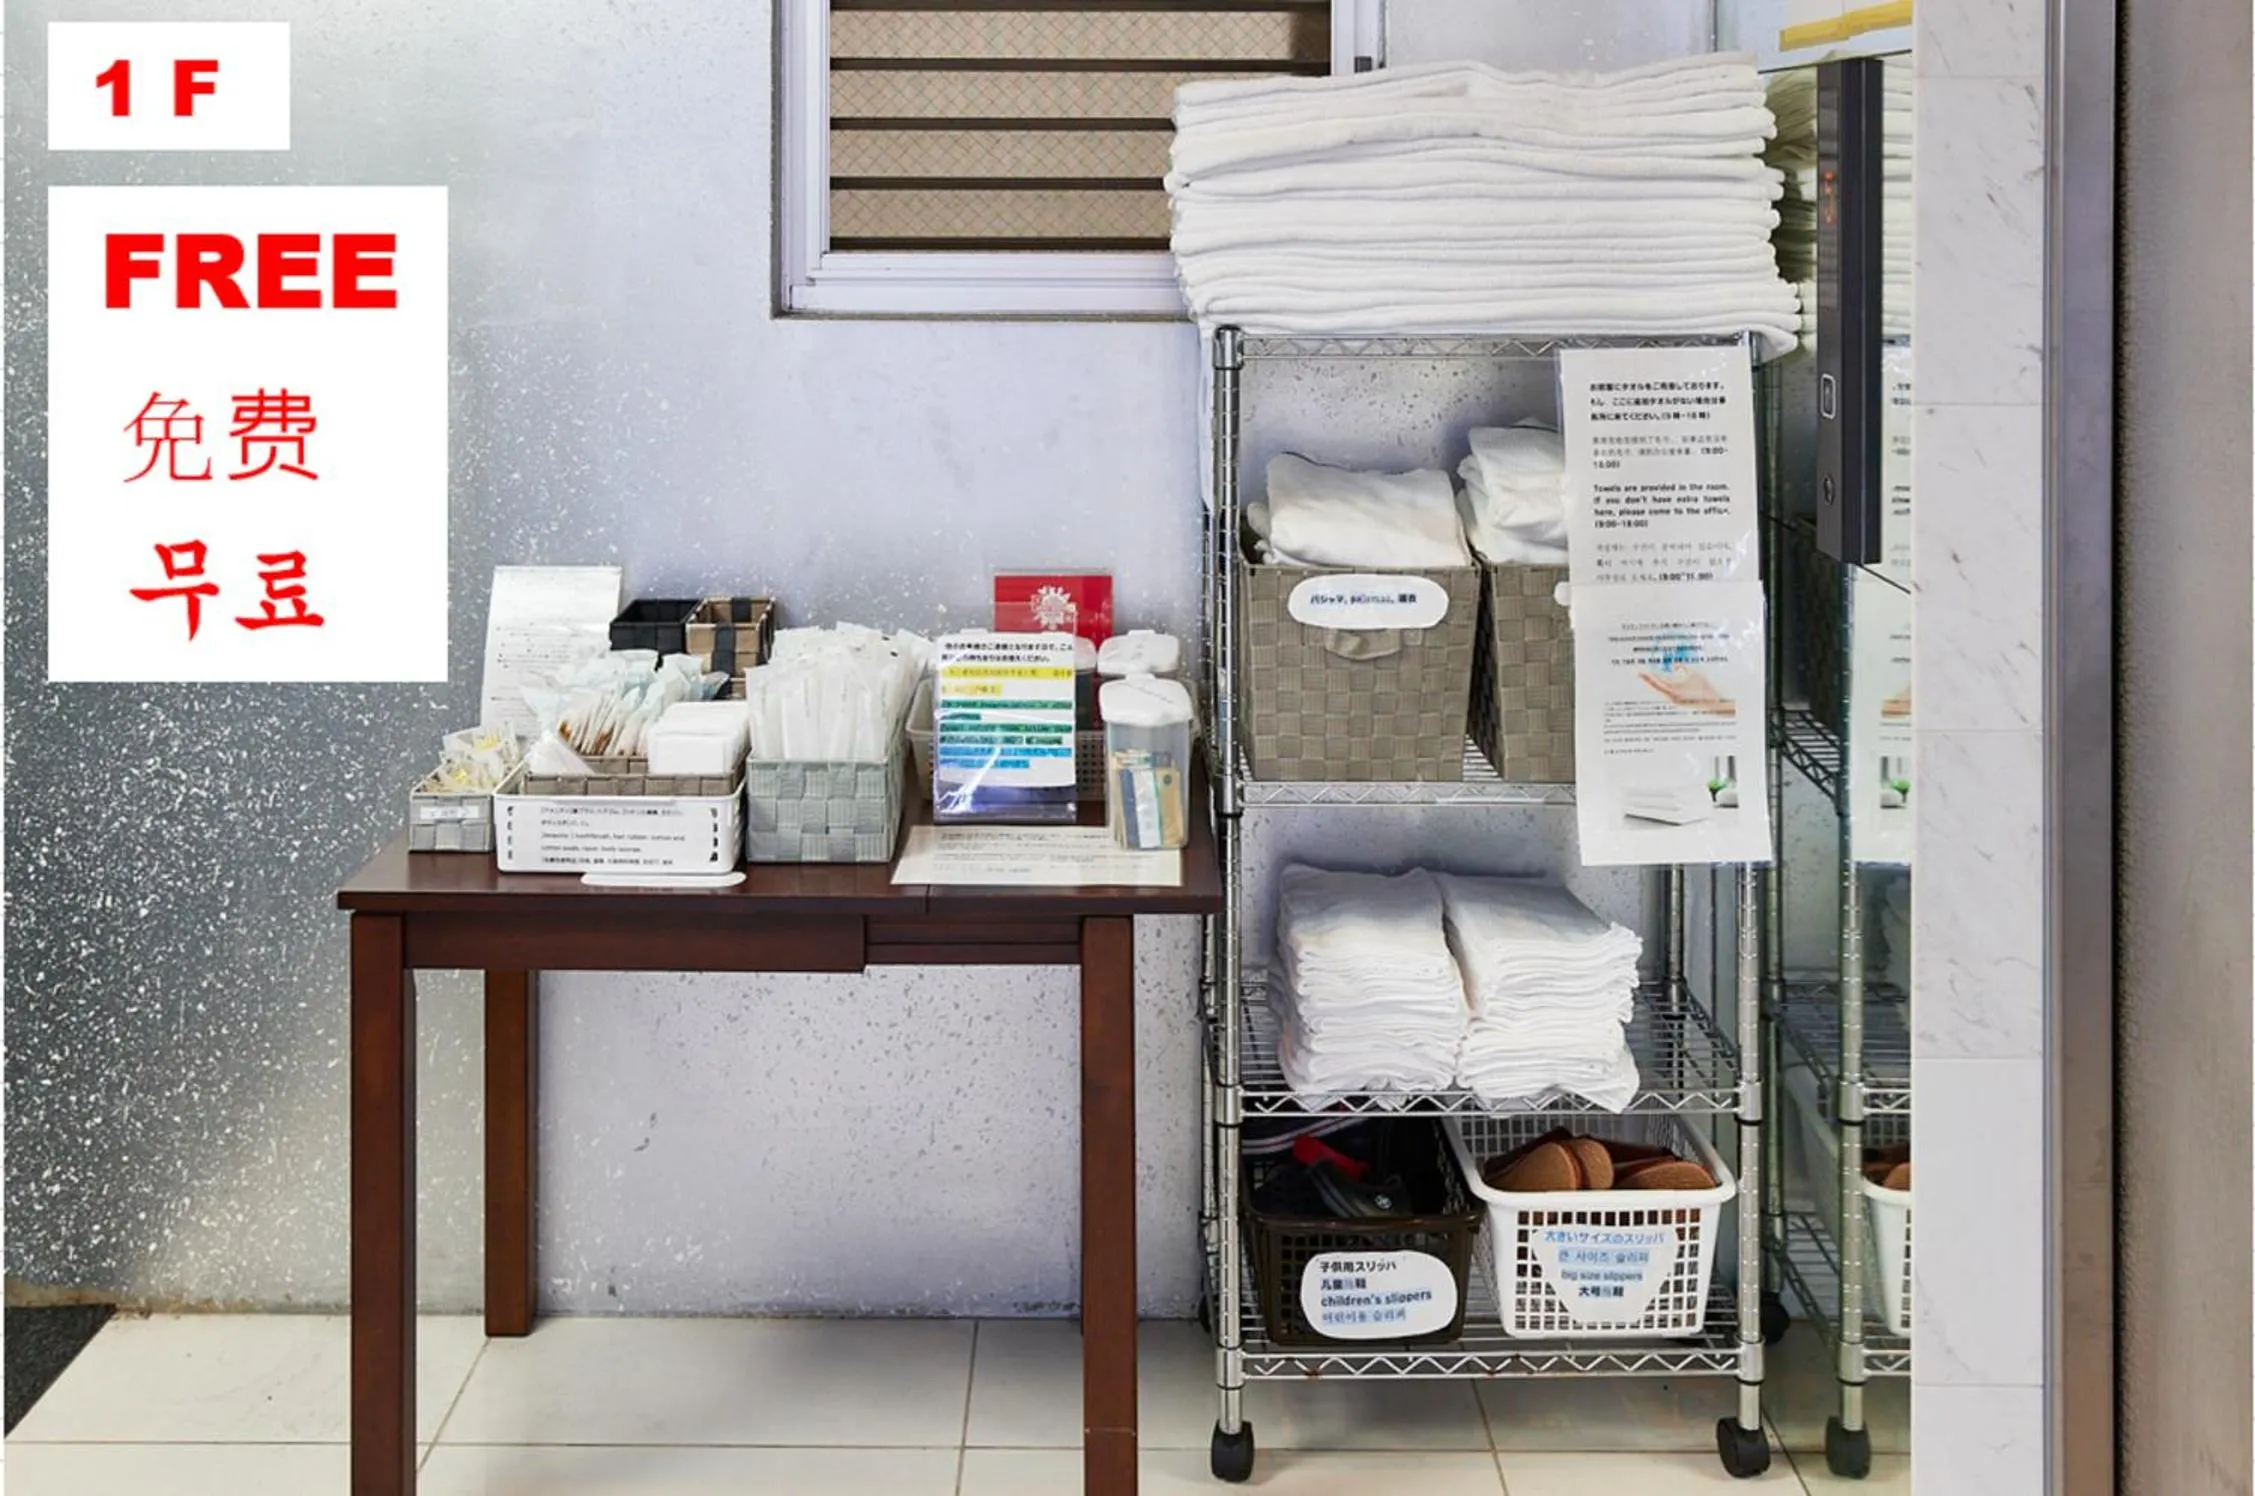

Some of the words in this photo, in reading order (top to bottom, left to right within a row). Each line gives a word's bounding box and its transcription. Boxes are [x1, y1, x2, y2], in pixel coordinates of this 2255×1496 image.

[1640, 484, 1676, 493] provided
[1689, 483, 1703, 491] the
[1652, 495, 1672, 503] have
[1618, 508, 1646, 518] please
[1648, 508, 1671, 516] come
[1674, 507, 1683, 516] to
[1686, 507, 1700, 515] the
[1545, 1231, 1665, 1244] 大きいサイズのスリッパ
[1576, 1251, 1610, 1263] 사이즈
[1561, 1269, 1577, 1281] big
[1580, 1271, 1600, 1280] size
[1603, 1270, 1643, 1282] slippers
[1320, 1293, 1382, 1307] children's
[1385, 1290, 1432, 1305] slippers
